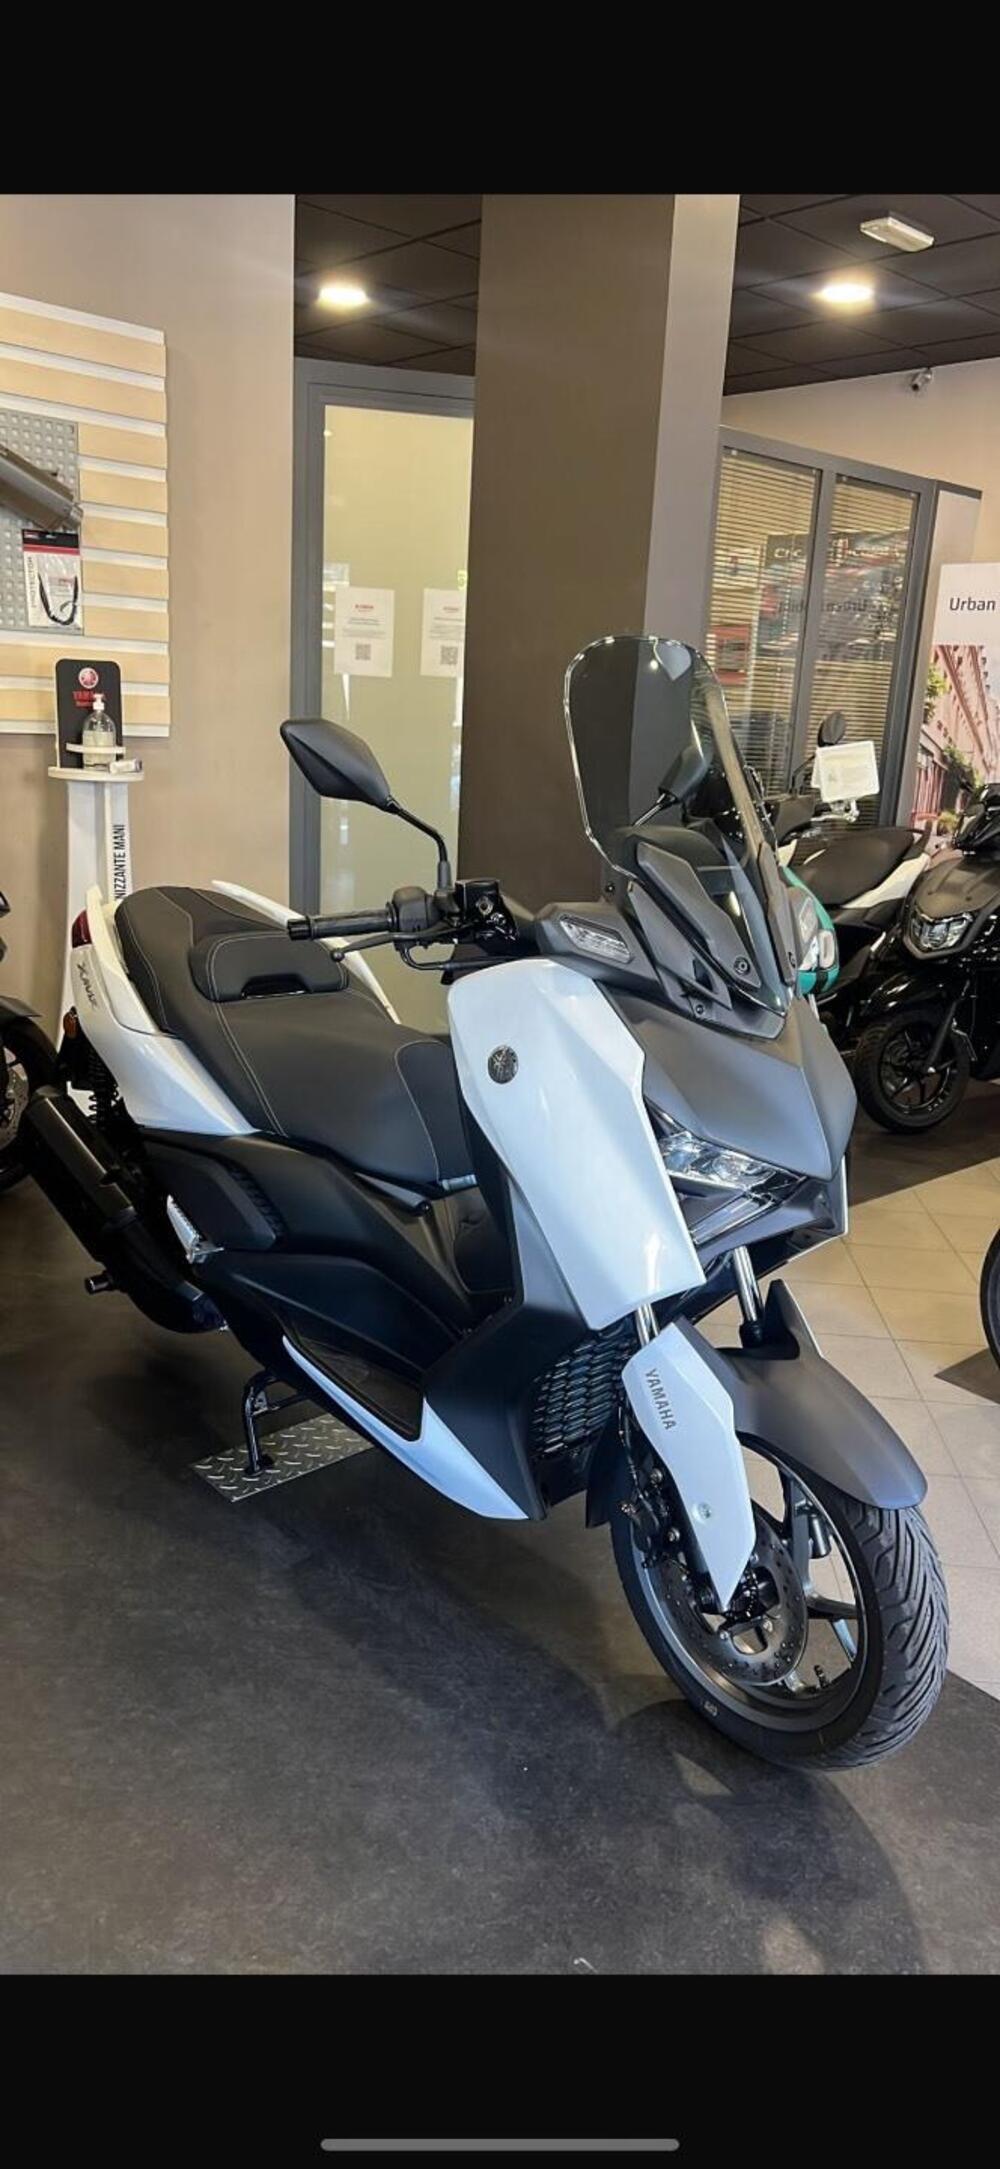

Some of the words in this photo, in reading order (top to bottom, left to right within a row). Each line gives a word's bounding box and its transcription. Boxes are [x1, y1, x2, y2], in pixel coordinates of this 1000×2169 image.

[950, 596, 996, 611] Urban
[112, 824, 126, 850] MANI
[645, 1368, 677, 1430] YAMAHA
